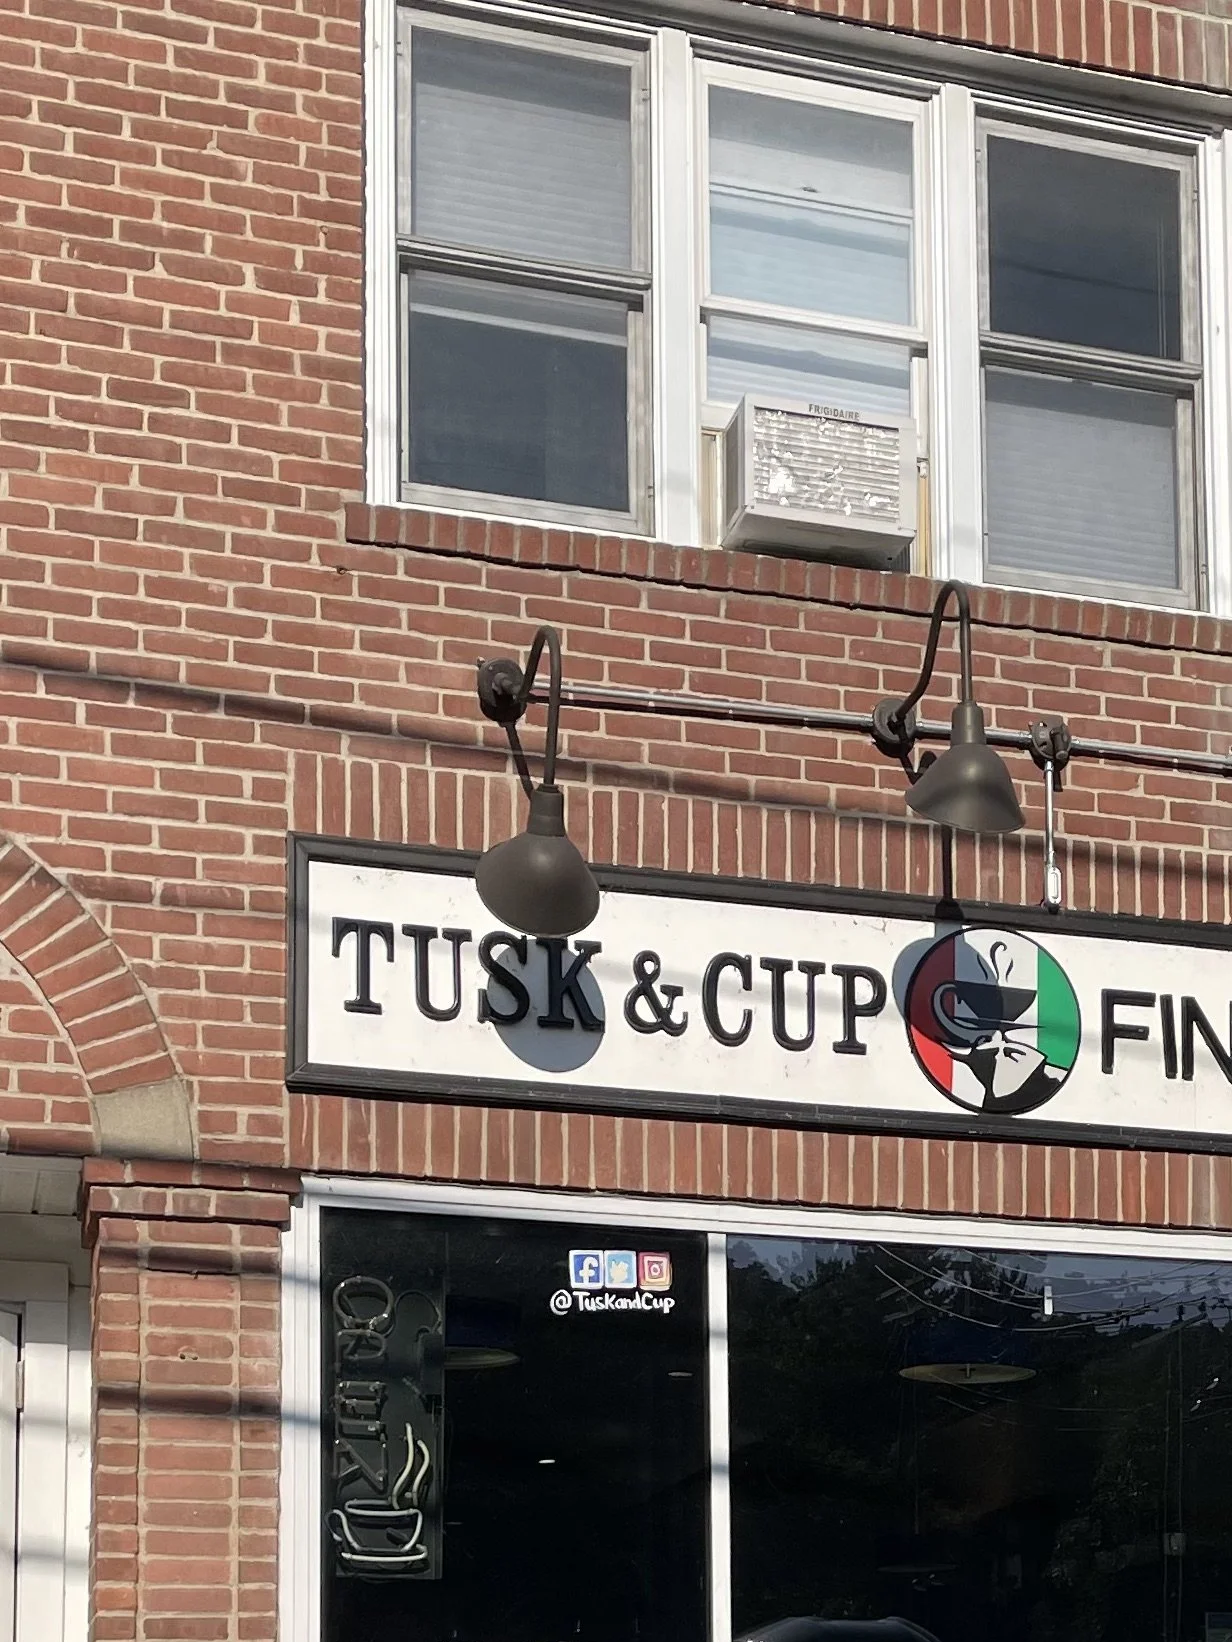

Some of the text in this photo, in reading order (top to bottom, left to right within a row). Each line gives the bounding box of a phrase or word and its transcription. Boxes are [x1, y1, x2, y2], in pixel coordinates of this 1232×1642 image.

[808, 403, 861, 420] FRIGIDAIRE
[331, 916, 605, 1033] TUSK
[702, 951, 887, 1056] CUP
